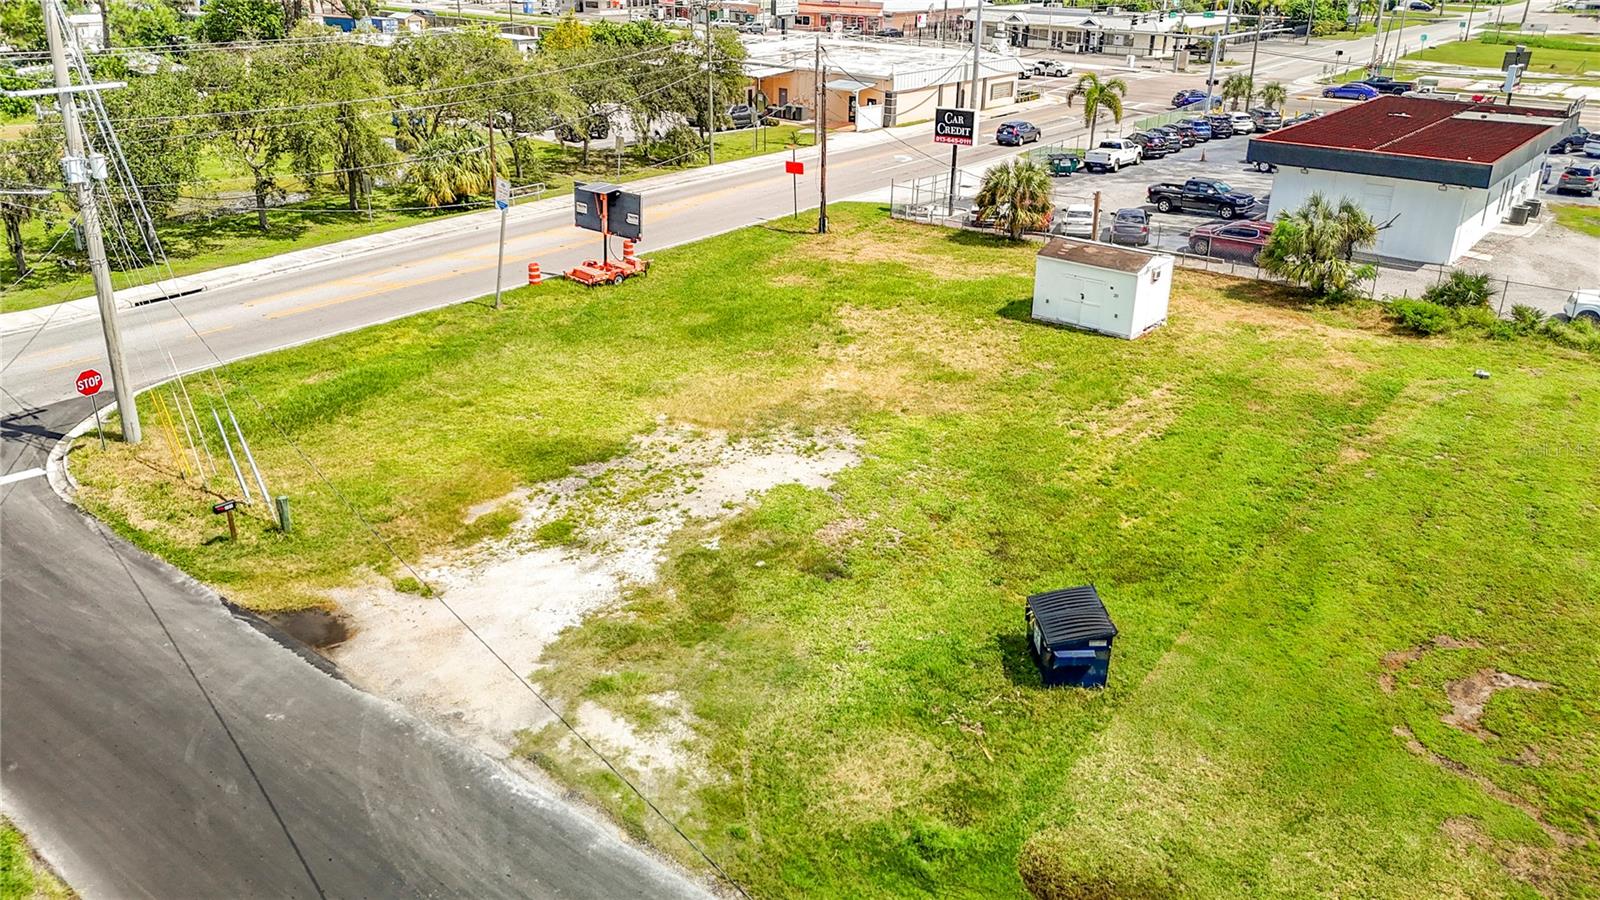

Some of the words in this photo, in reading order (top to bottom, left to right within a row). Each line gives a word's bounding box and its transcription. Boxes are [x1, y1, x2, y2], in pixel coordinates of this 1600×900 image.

[944, 112, 964, 124] CAR
[937, 123, 971, 136] CREDIT
[78, 375, 101, 391] STOP
